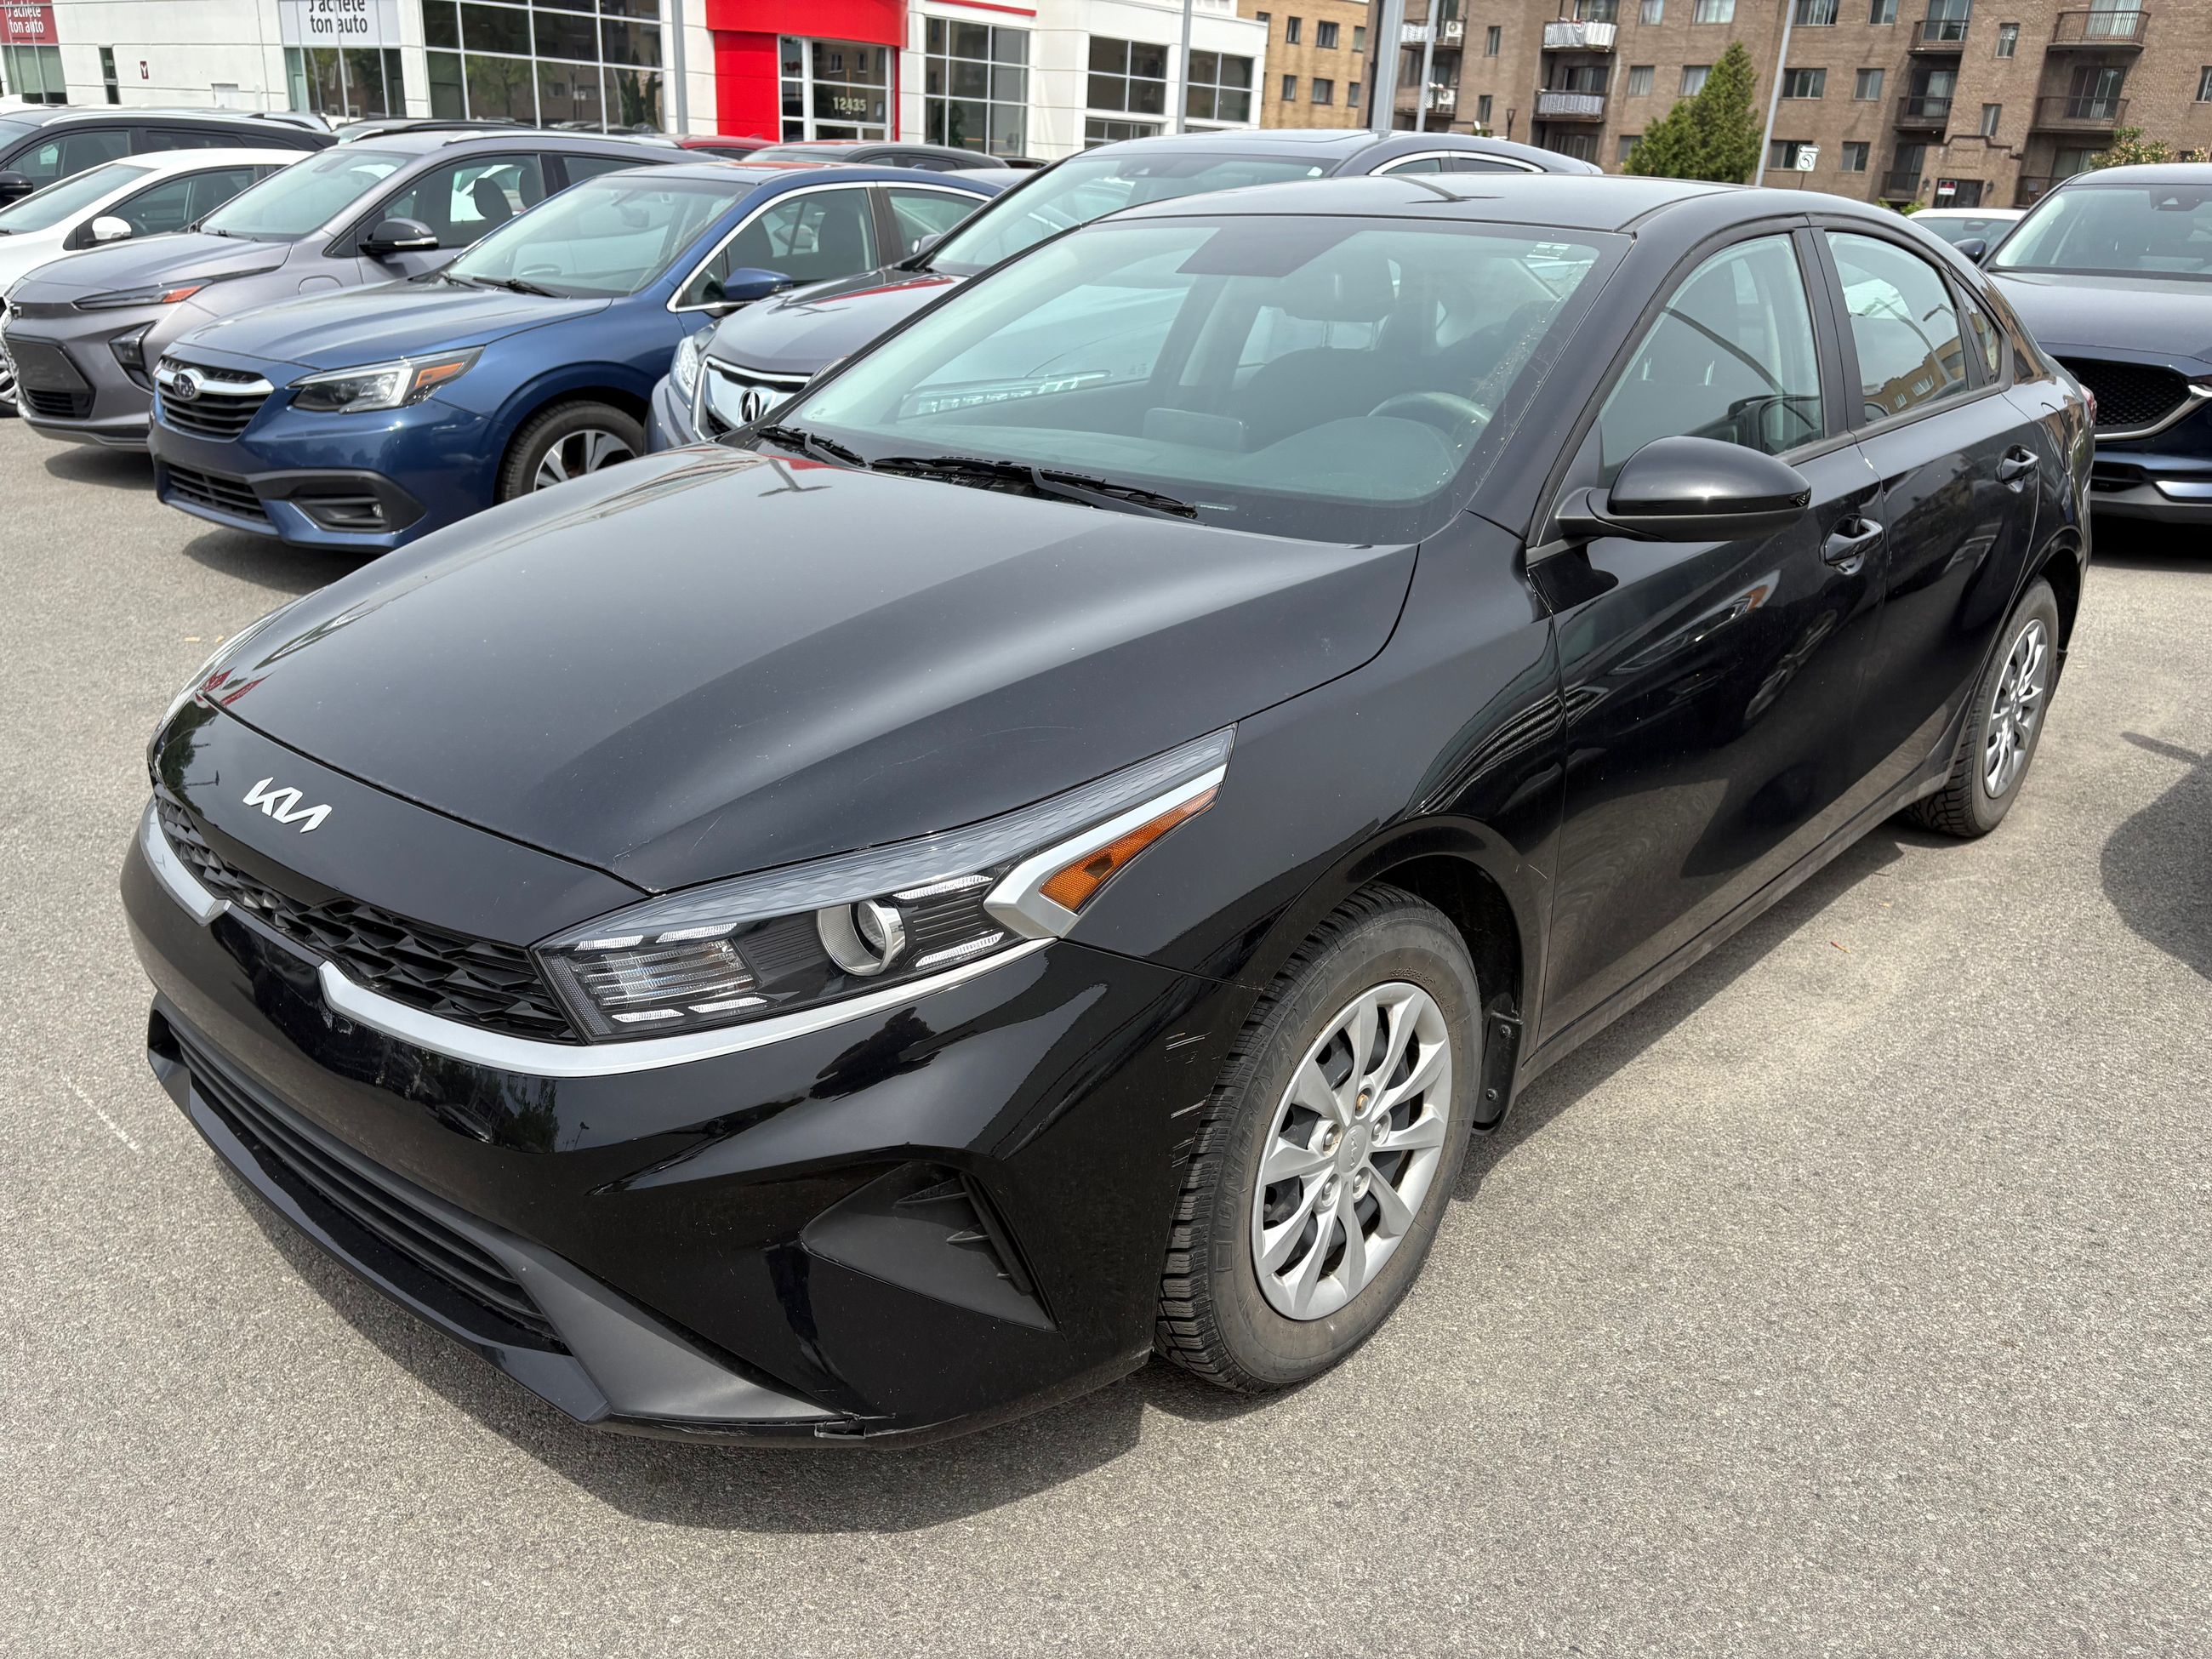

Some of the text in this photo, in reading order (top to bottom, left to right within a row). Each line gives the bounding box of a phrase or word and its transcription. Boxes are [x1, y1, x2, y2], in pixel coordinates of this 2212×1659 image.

[9, 19, 44, 33] ton auto
[310, 14, 368, 33] ton auto
[833, 96, 867, 111] 12435
[242, 777, 333, 833] KIA
